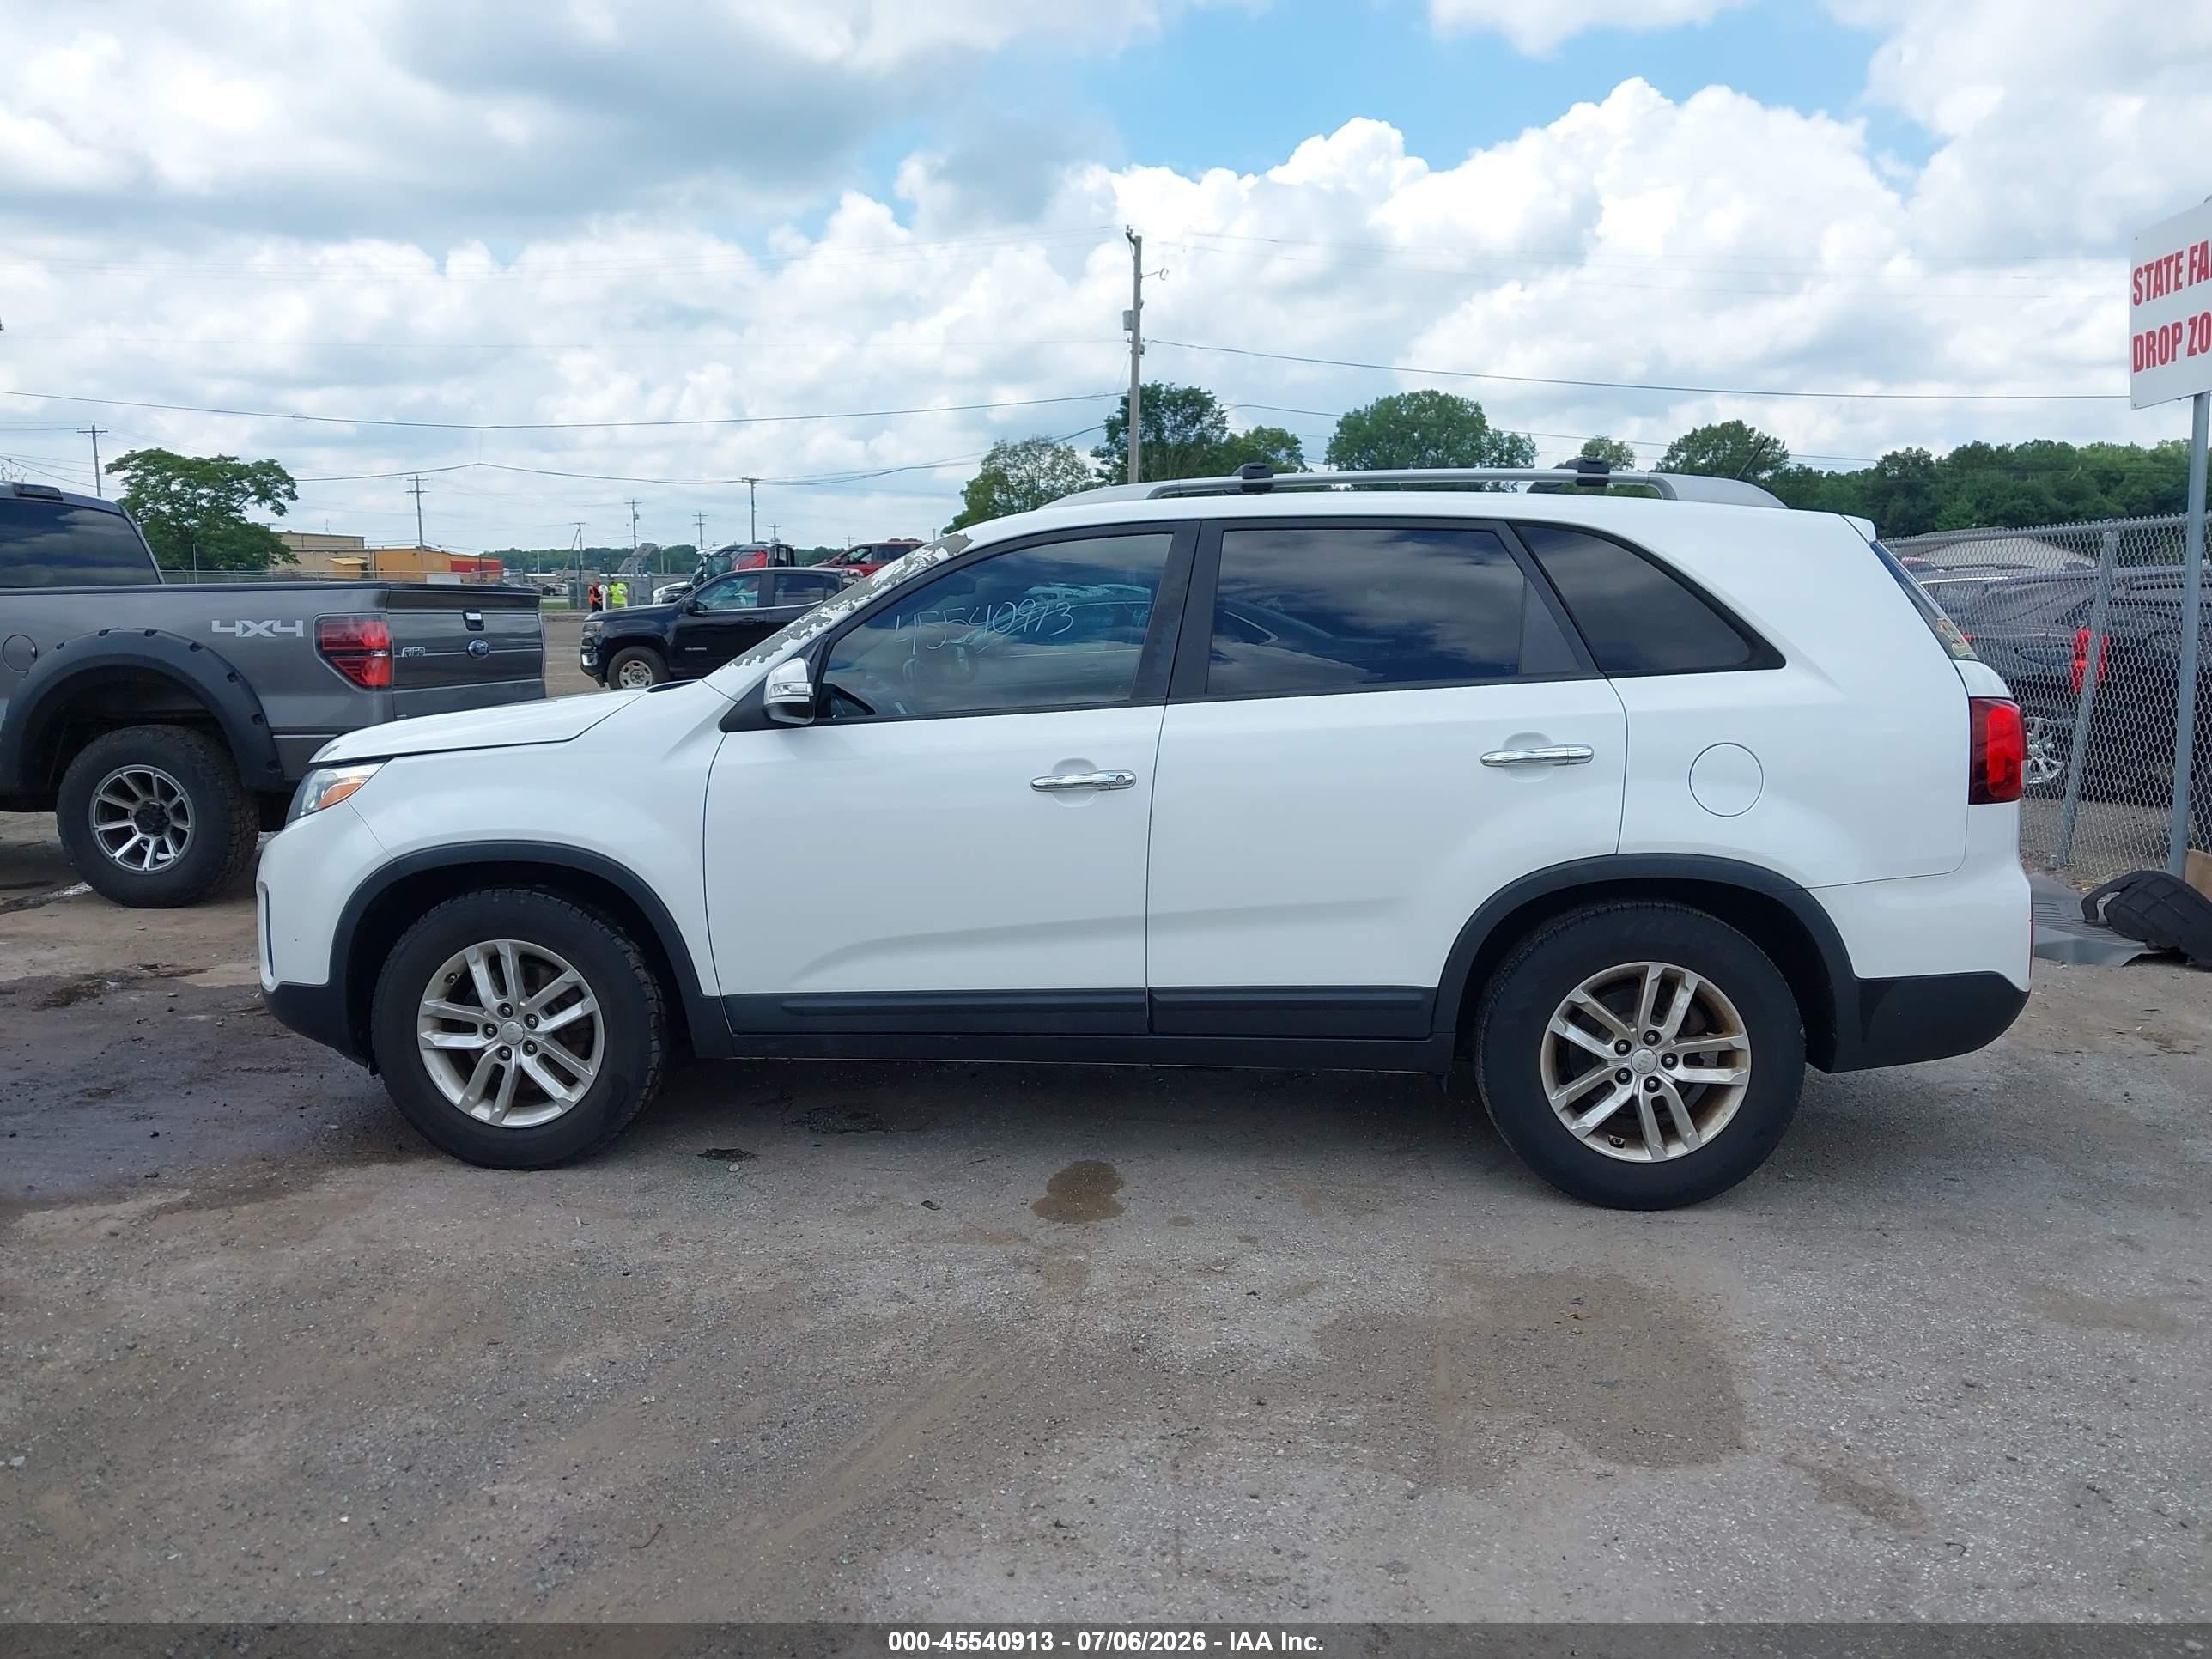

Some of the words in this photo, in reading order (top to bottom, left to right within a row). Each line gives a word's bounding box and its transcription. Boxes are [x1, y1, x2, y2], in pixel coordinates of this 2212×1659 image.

[2132, 251, 2184, 306] STATE
[2188, 240, 2212, 288] FA
[2133, 321, 2183, 373] DROP
[211, 620, 304, 637] 4X4
